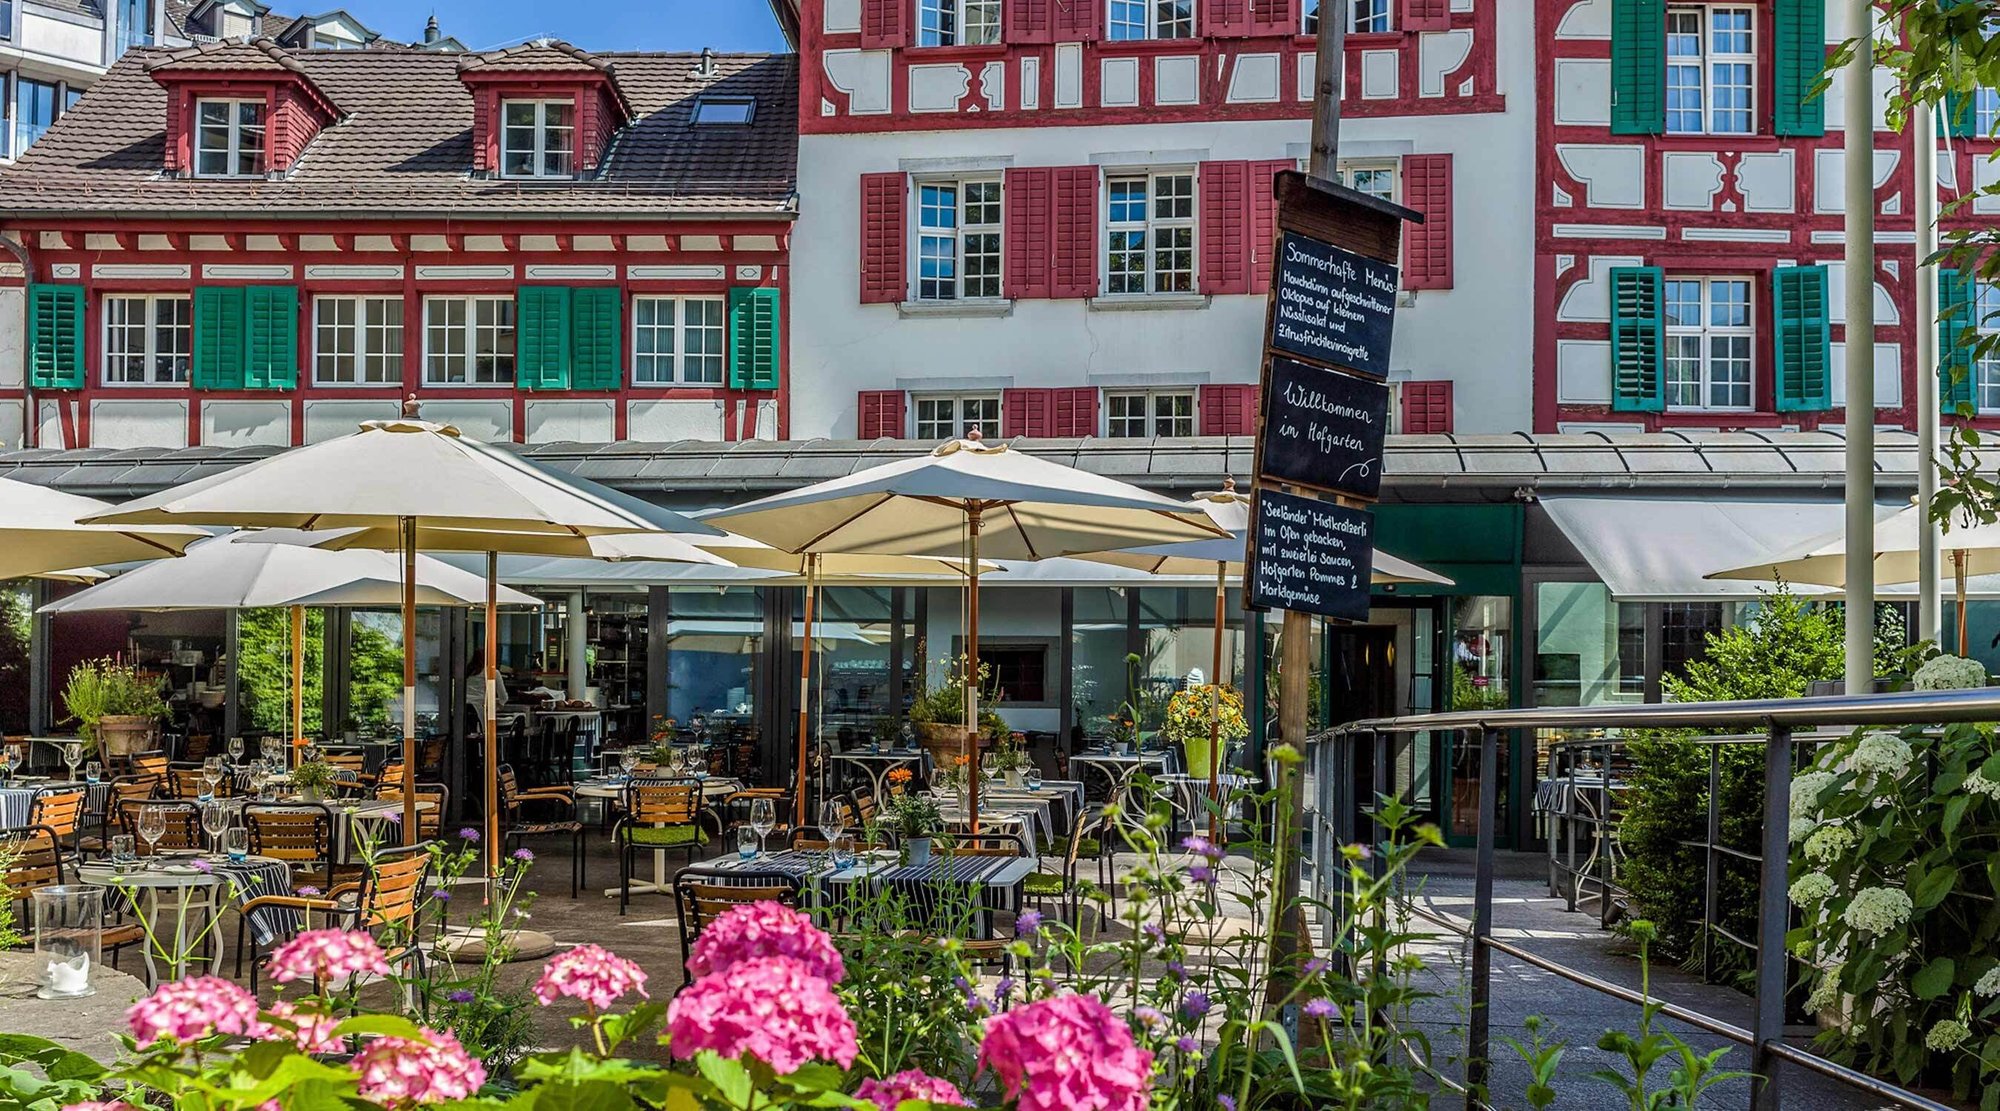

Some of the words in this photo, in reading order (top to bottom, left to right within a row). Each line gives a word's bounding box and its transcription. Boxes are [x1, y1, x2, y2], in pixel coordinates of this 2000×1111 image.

[1286, 242, 1357, 283] Sommerhafte
[1281, 288, 1313, 311] Oktopus
[1316, 300, 1331, 314] auf
[1333, 302, 1364, 323] kleinem
[1331, 287, 1392, 315] aufgeschnittener
[1280, 305, 1327, 328] Nüsslisalat
[1329, 319, 1346, 334] und
[1284, 381, 1372, 424] Willkommen
[1279, 415, 1299, 438] im
[1308, 421, 1364, 454] Hofgarten
[1264, 524, 1275, 537] im
[1280, 525, 1300, 544] Ofen
[1304, 531, 1346, 551] gebacken,
[1262, 542, 1276, 556] mit
[1281, 548, 1317, 564] zweierlei
[1261, 561, 1305, 584] Hofgarten
[1310, 567, 1345, 586] Pommes
[1260, 581, 1320, 607] Marktgemüse
